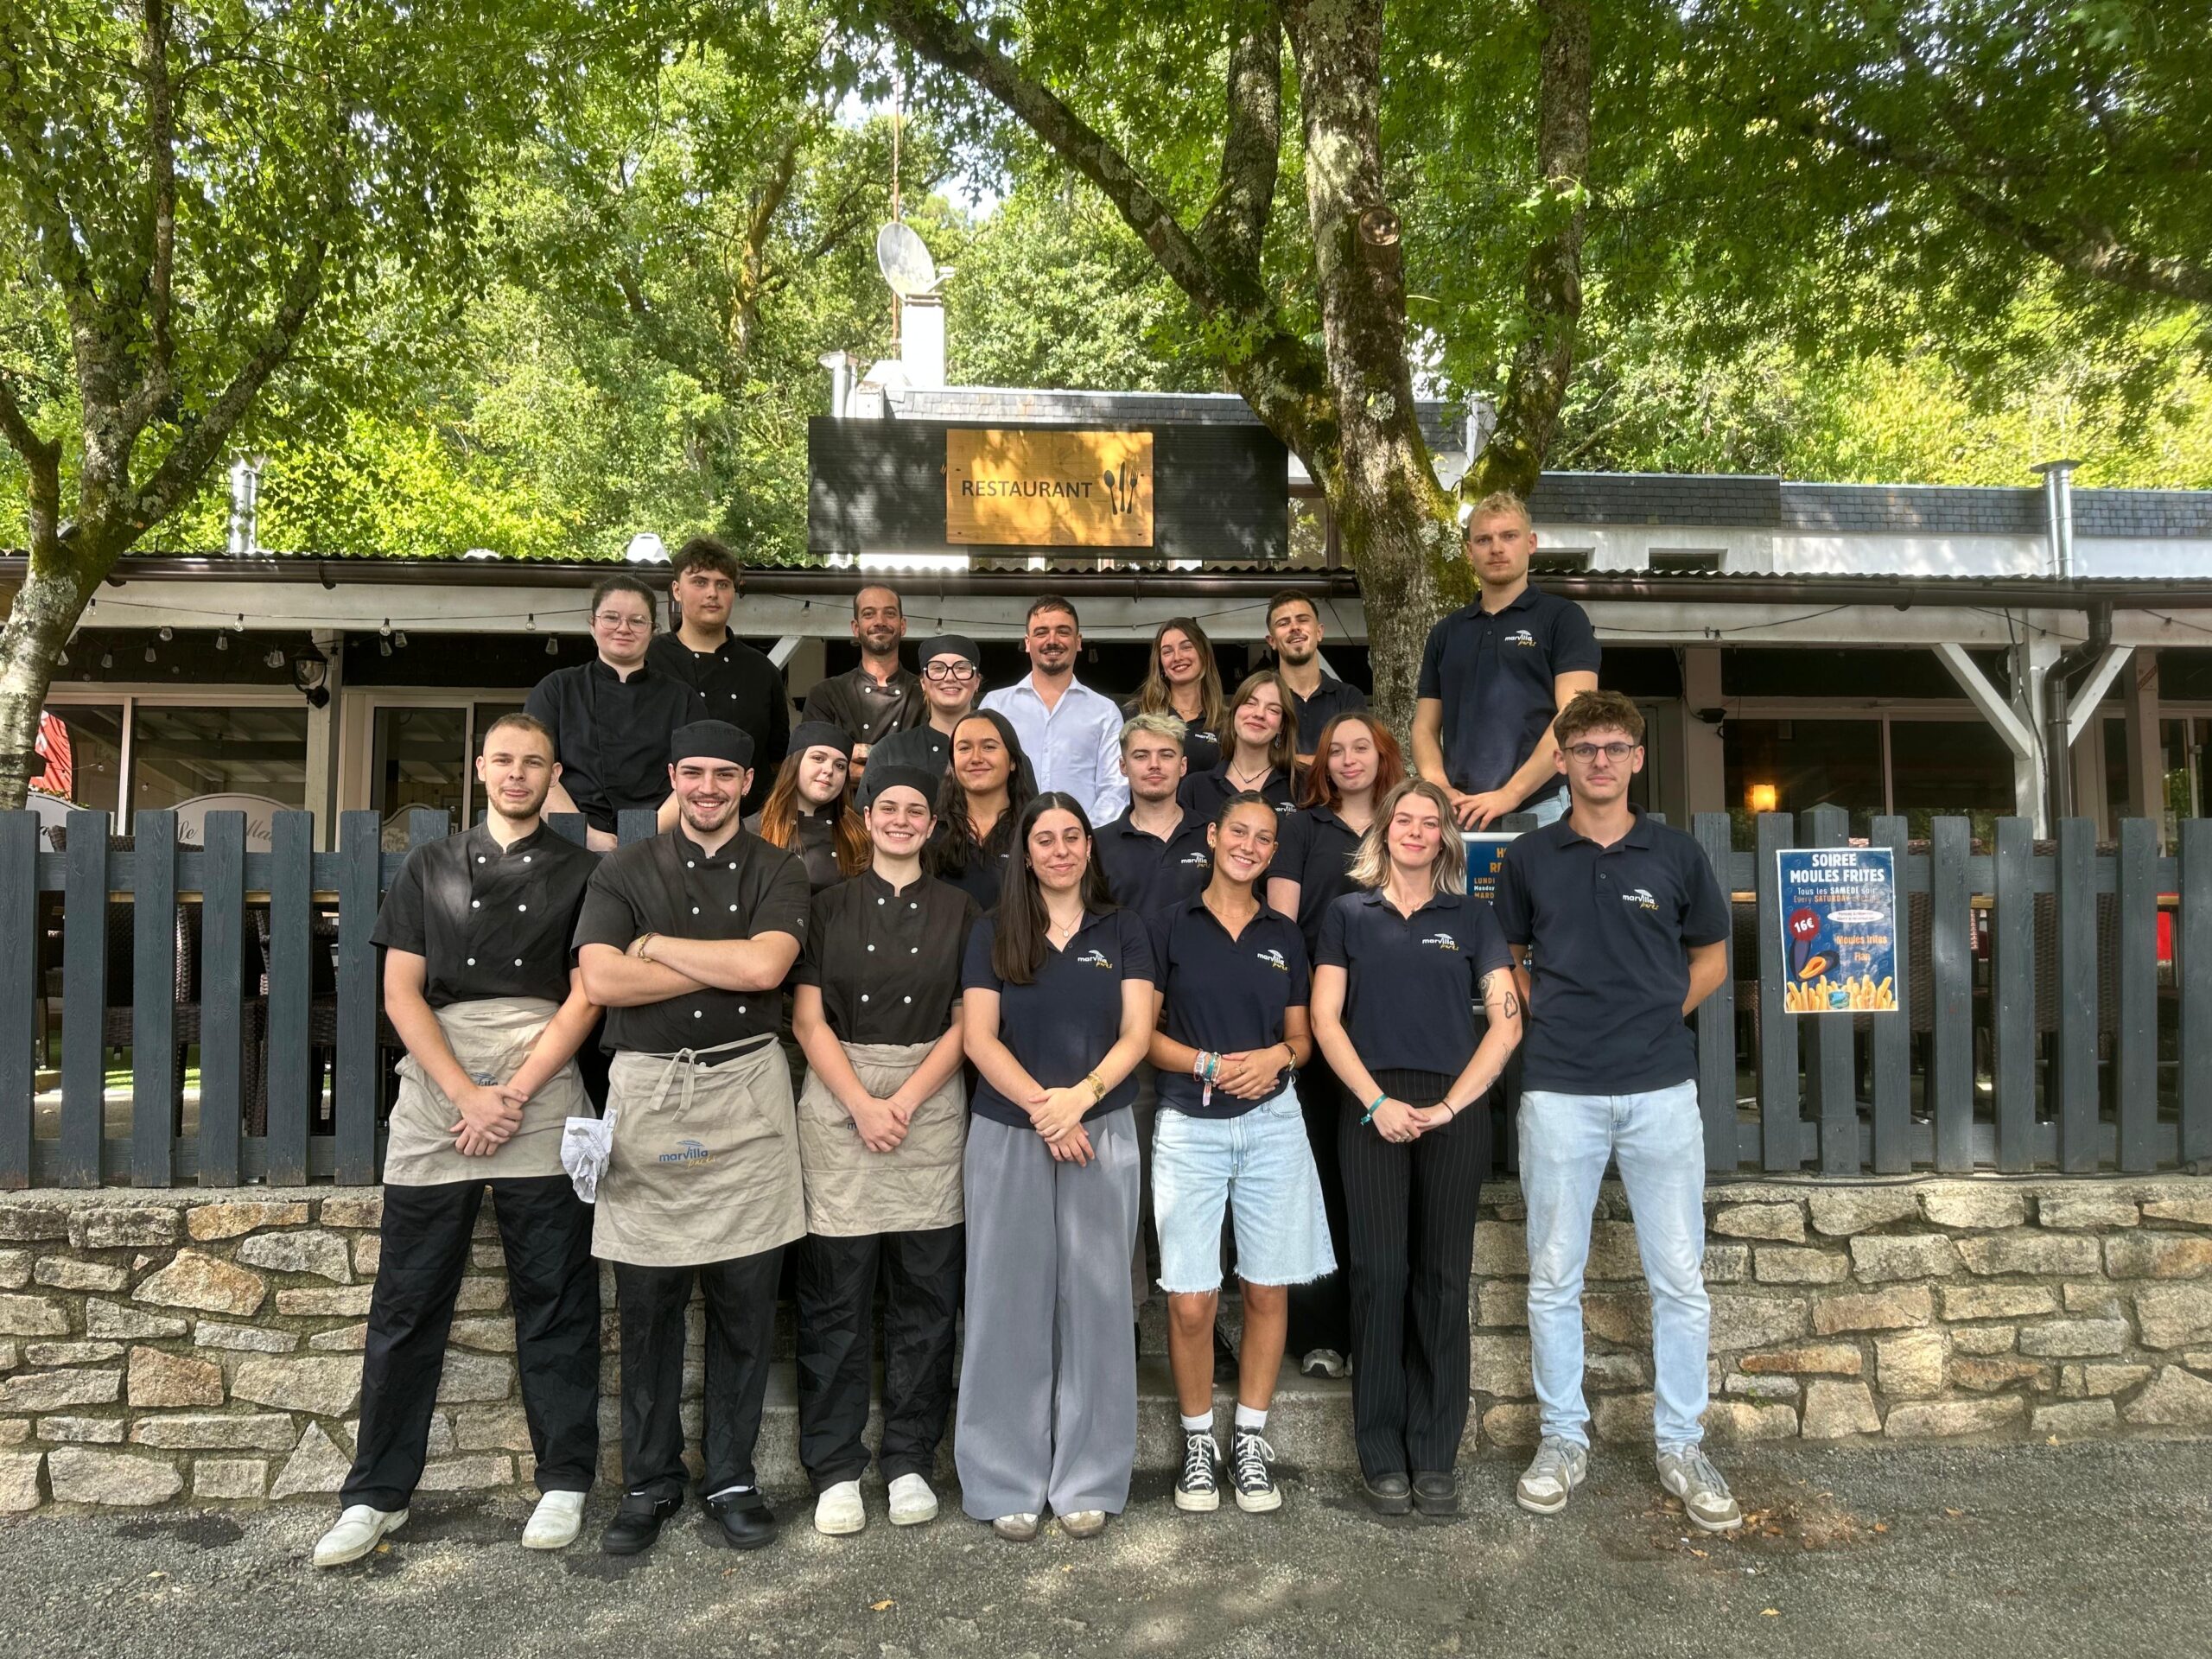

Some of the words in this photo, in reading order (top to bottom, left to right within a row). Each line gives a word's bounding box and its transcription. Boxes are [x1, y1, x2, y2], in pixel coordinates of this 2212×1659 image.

[961, 480, 1093, 499] RESTAURANT
[1504, 633, 1533, 642] marvilla
[1180, 855, 1207, 864] marvilla
[1812, 853, 1857, 868] SOIREE
[1790, 869, 1840, 883] MOULES
[1843, 868, 1885, 882] FRITES
[1830, 886, 1859, 894] SAMEDI
[1622, 893, 1656, 905] marvilla
[1793, 895, 1812, 905] Every
[1815, 894, 1850, 903] SATURDAY
[1794, 917, 1815, 933] 16€
[1836, 935, 1866, 945] Moules
[1077, 954, 1108, 963] marvilla
[1256, 953, 1285, 966] marvilla
[1853, 951, 1871, 962] Flan
[658, 1147, 709, 1162] marvilla
